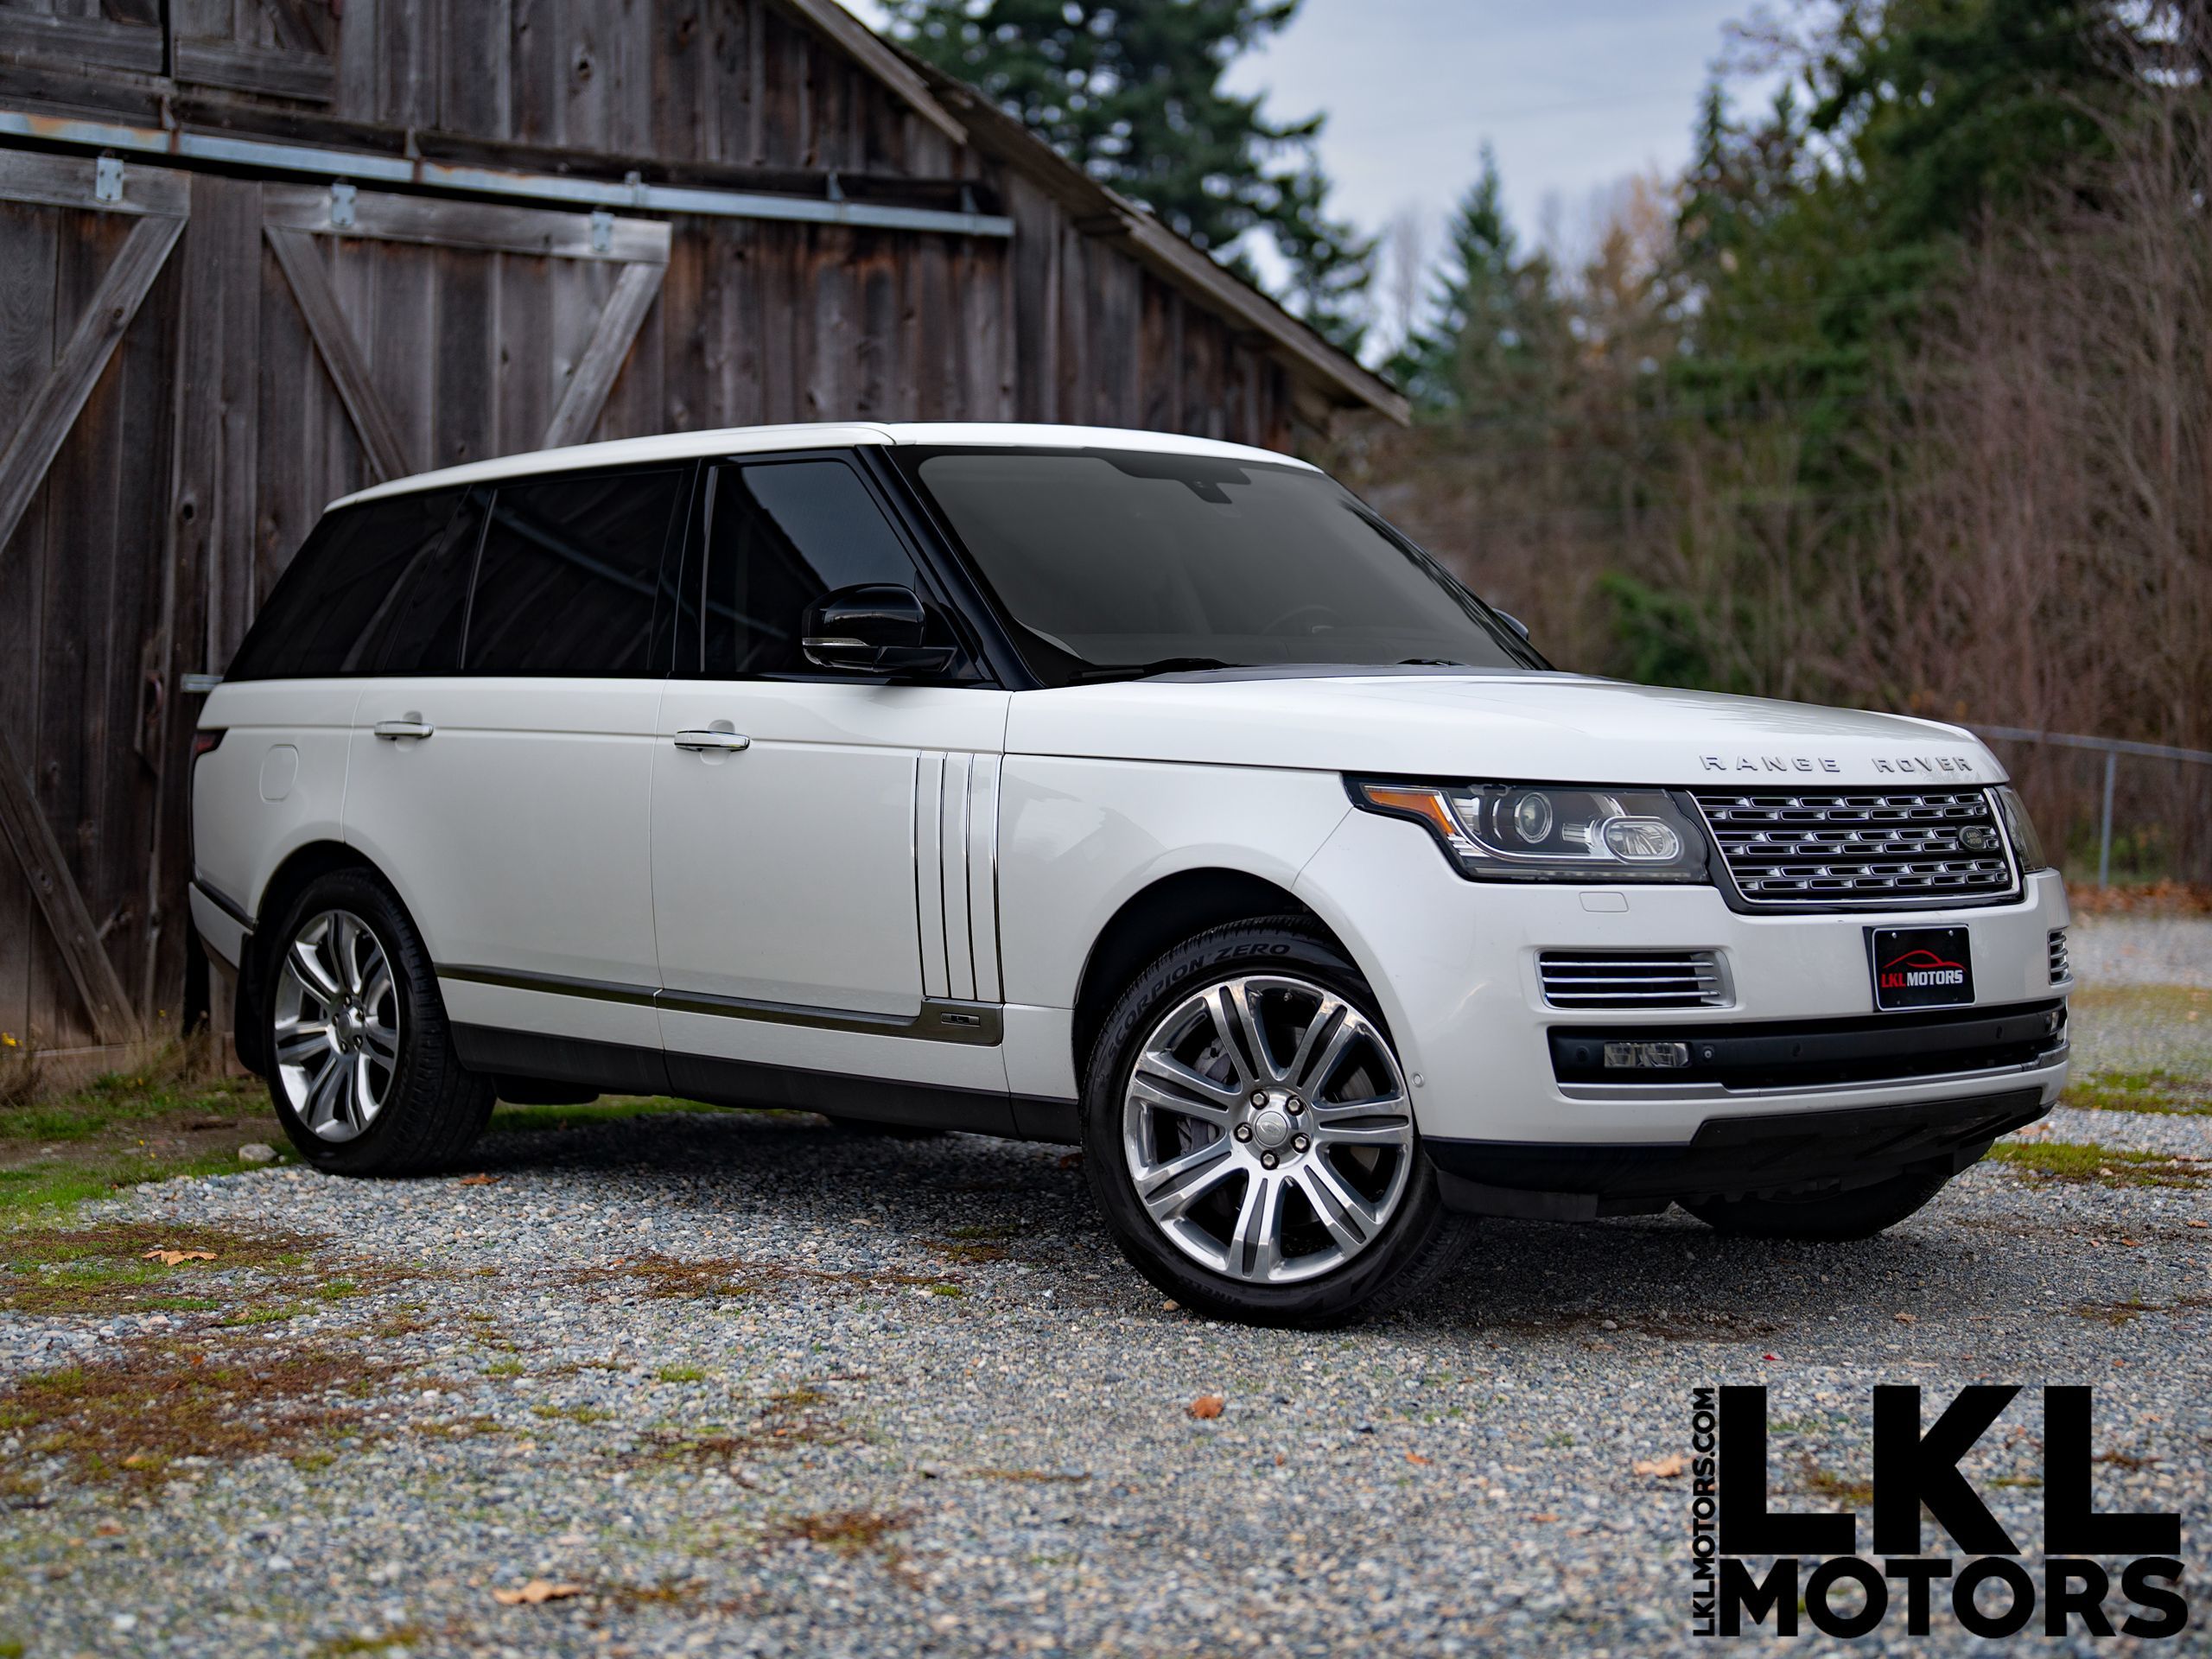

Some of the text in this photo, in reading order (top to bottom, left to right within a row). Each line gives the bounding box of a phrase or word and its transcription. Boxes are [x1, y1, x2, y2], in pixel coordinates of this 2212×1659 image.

[1699, 754, 1973, 772] RANGE ROVER
[1108, 944, 1291, 1059] SCORPION ZERO
